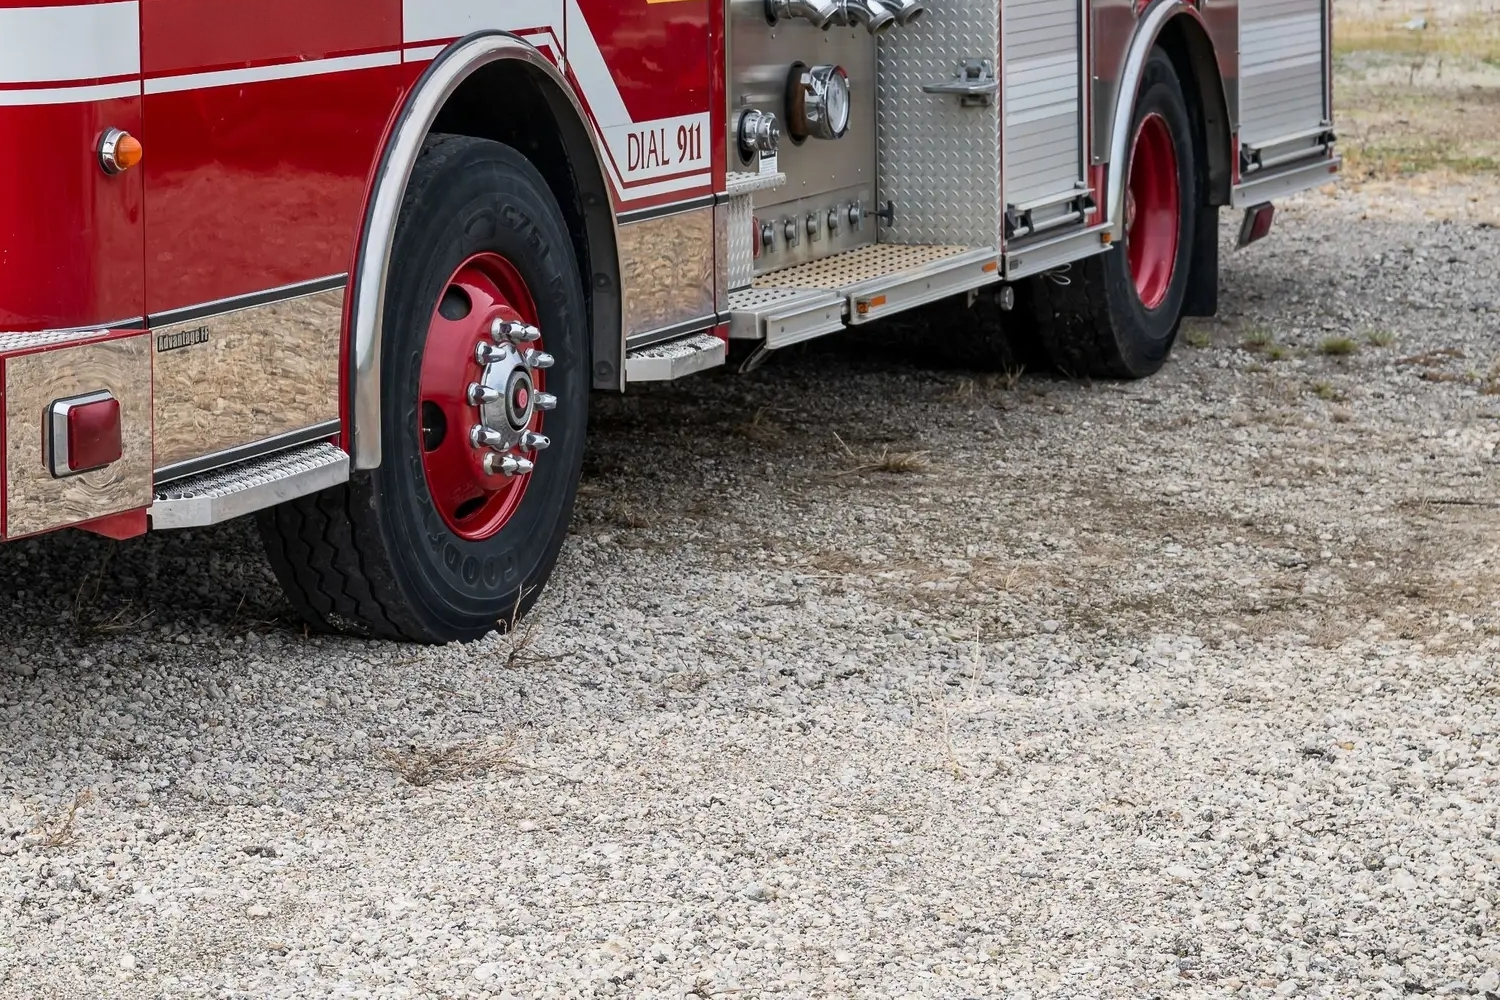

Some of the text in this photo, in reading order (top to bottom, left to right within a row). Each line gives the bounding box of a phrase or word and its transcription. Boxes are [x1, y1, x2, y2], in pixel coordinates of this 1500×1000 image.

[627, 121, 702, 172] DIAL 911
[158, 330, 200, 351] Advantage
